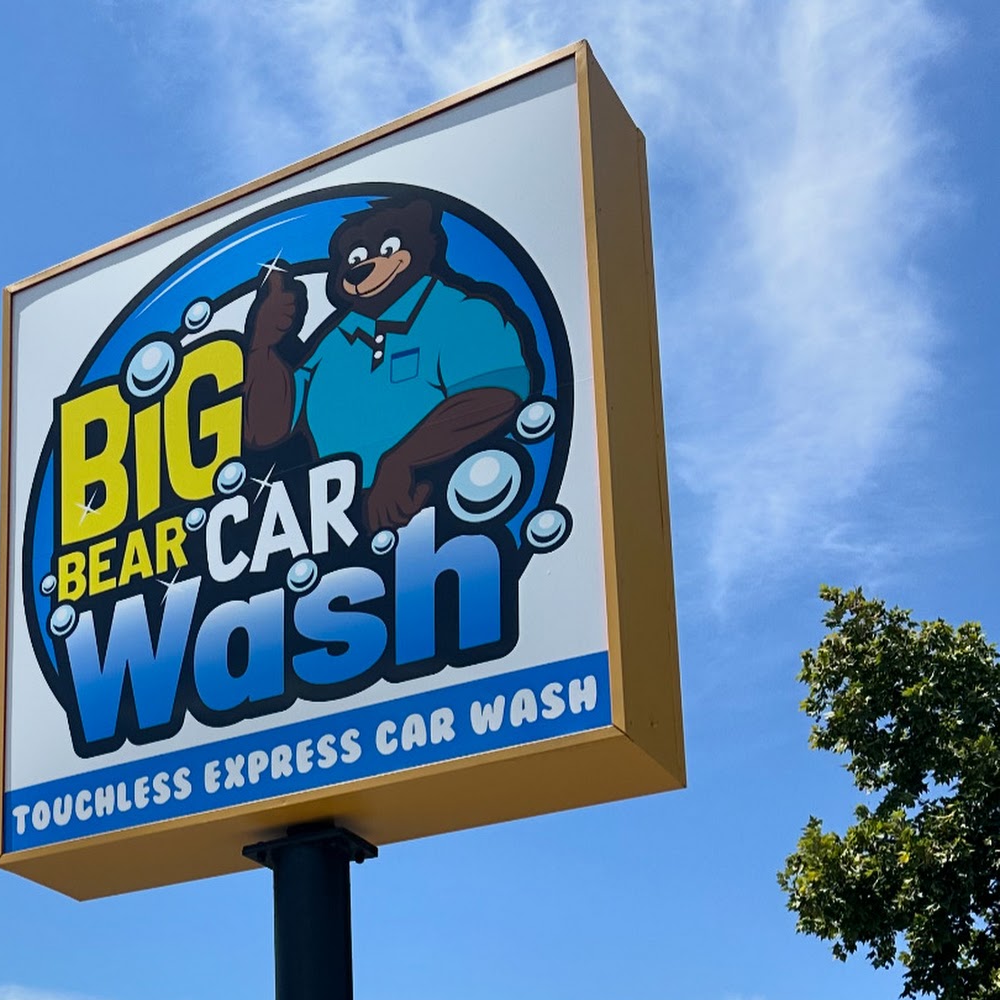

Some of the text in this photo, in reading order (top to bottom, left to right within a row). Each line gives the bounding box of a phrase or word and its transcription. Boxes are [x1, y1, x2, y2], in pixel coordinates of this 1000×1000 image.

[58, 459, 358, 601] BEAR CAR
[66, 507, 502, 743] Wash
[13, 674, 598, 834] TOUCHLESS EXPRESS CAR WASH
